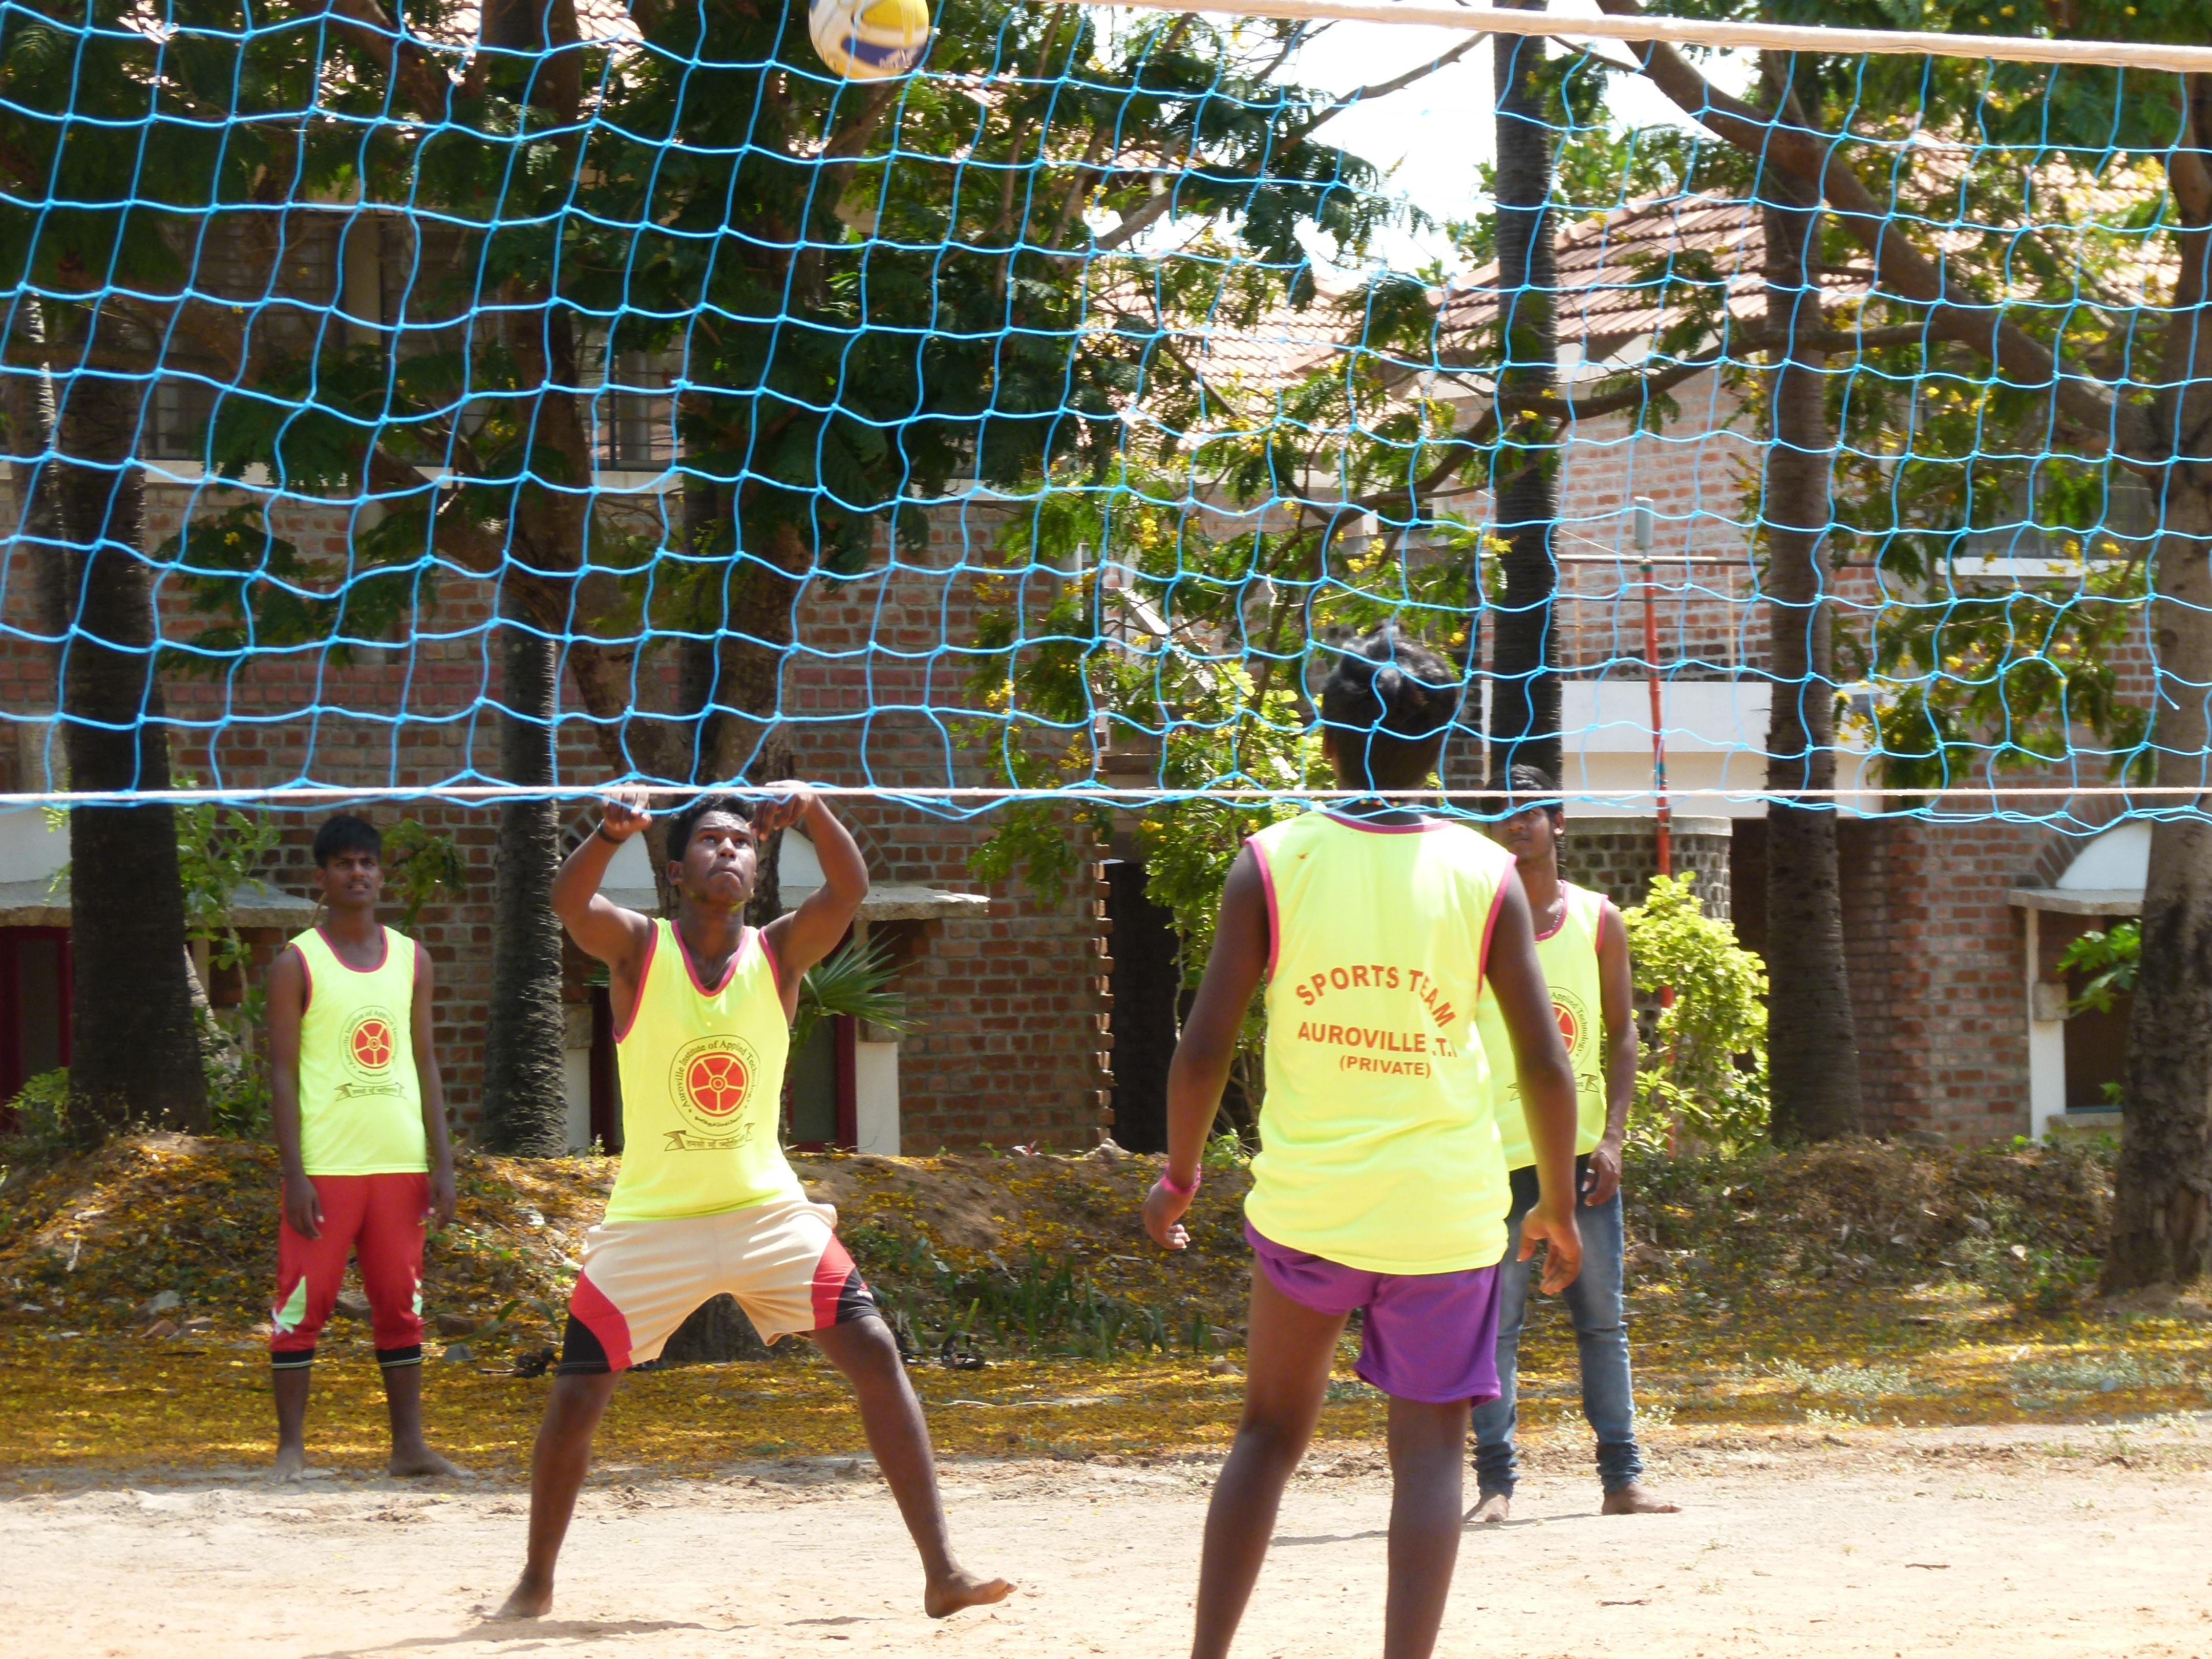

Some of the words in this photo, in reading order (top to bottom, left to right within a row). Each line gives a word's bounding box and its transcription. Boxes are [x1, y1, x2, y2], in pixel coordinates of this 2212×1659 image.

[1295, 964, 1399, 1006] SPORTS
[1409, 969, 1456, 1028] TEAM
[1298, 1022, 1427, 1053] AUROVILLE
[1577, 1007, 1588, 1054] Technology
[674, 1067, 690, 1108] Auroville
[708, 1040, 718, 1049] of
[719, 1040, 748, 1056] Applied
[1339, 1055, 1431, 1078] (PRIVATE)
